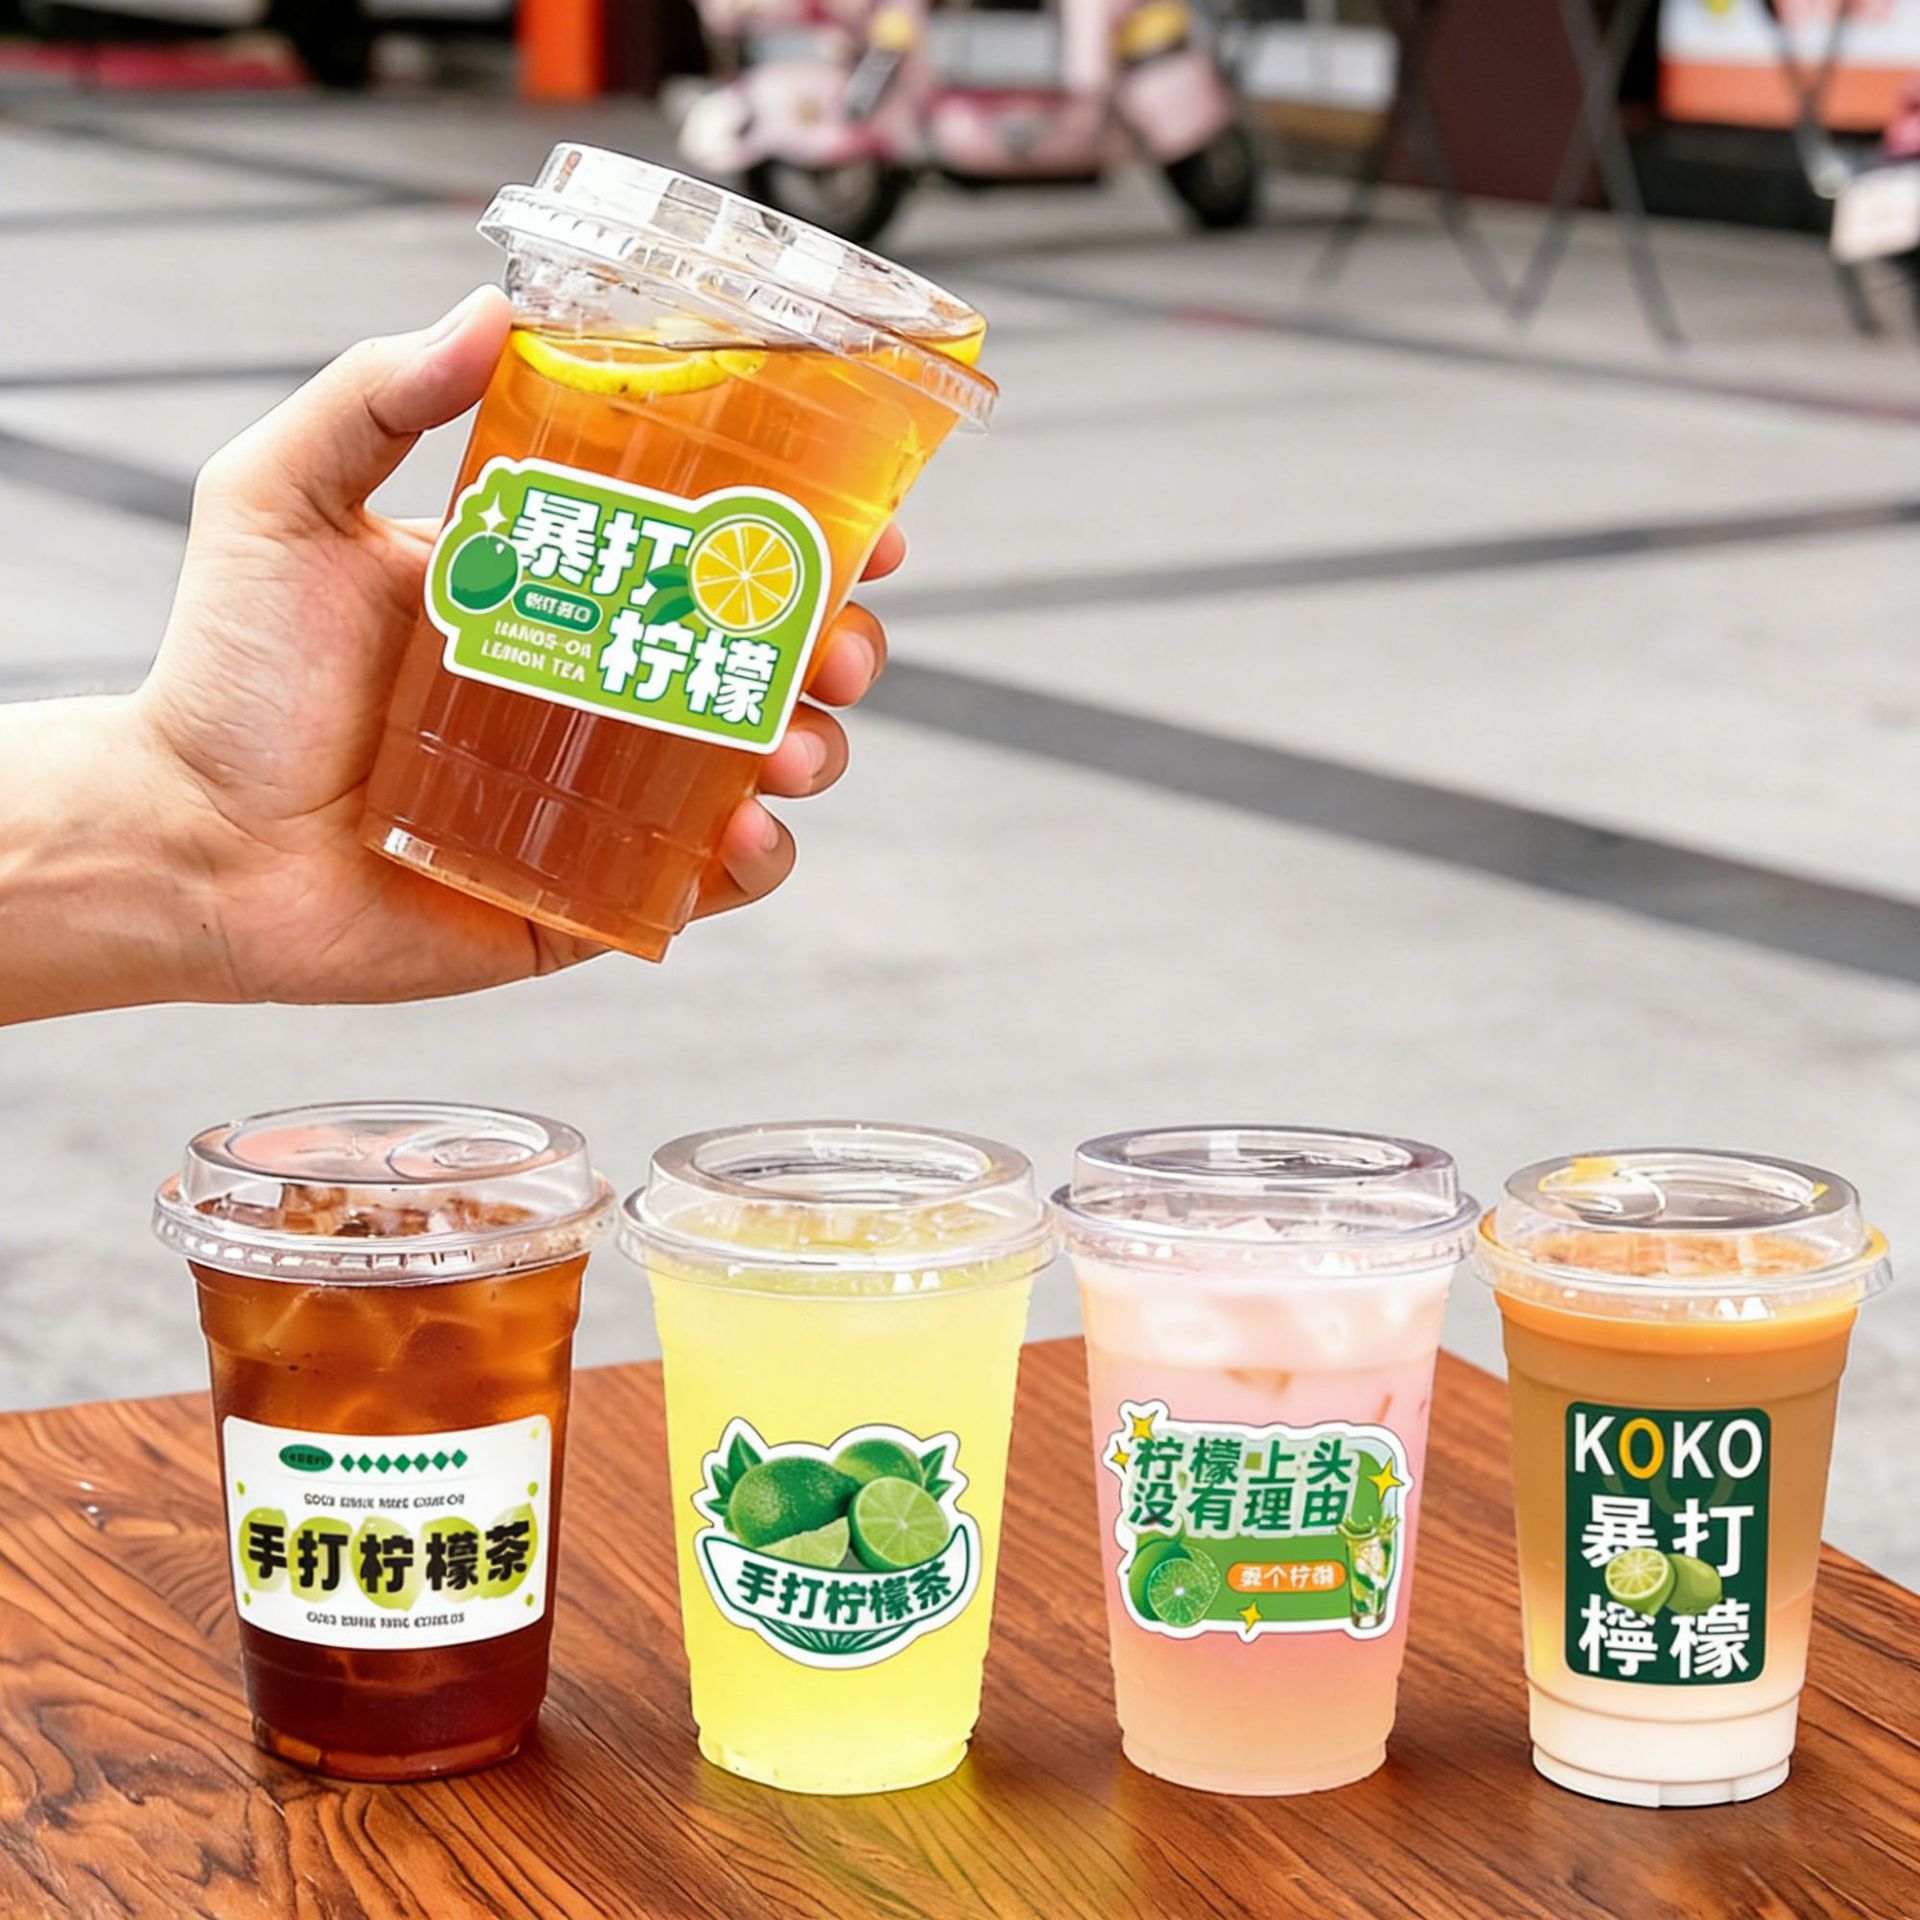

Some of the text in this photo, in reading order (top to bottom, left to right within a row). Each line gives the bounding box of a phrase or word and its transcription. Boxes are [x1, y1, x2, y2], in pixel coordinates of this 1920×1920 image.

[511, 487, 695, 606] 暴打
[552, 657, 585, 682] TEA
[600, 609, 779, 726] 柠檬
[1132, 1436, 1353, 1486] 柠檬上头
[1575, 1412, 1763, 1480] KOKO
[1128, 1483, 1349, 1531] 没有理由
[1580, 1494, 1755, 1578] 暴打
[248, 1521, 531, 1593] 手打柠檬茶
[736, 1560, 951, 1625] 手打柠檬茶
[1578, 1594, 1751, 1679] 檸檬
